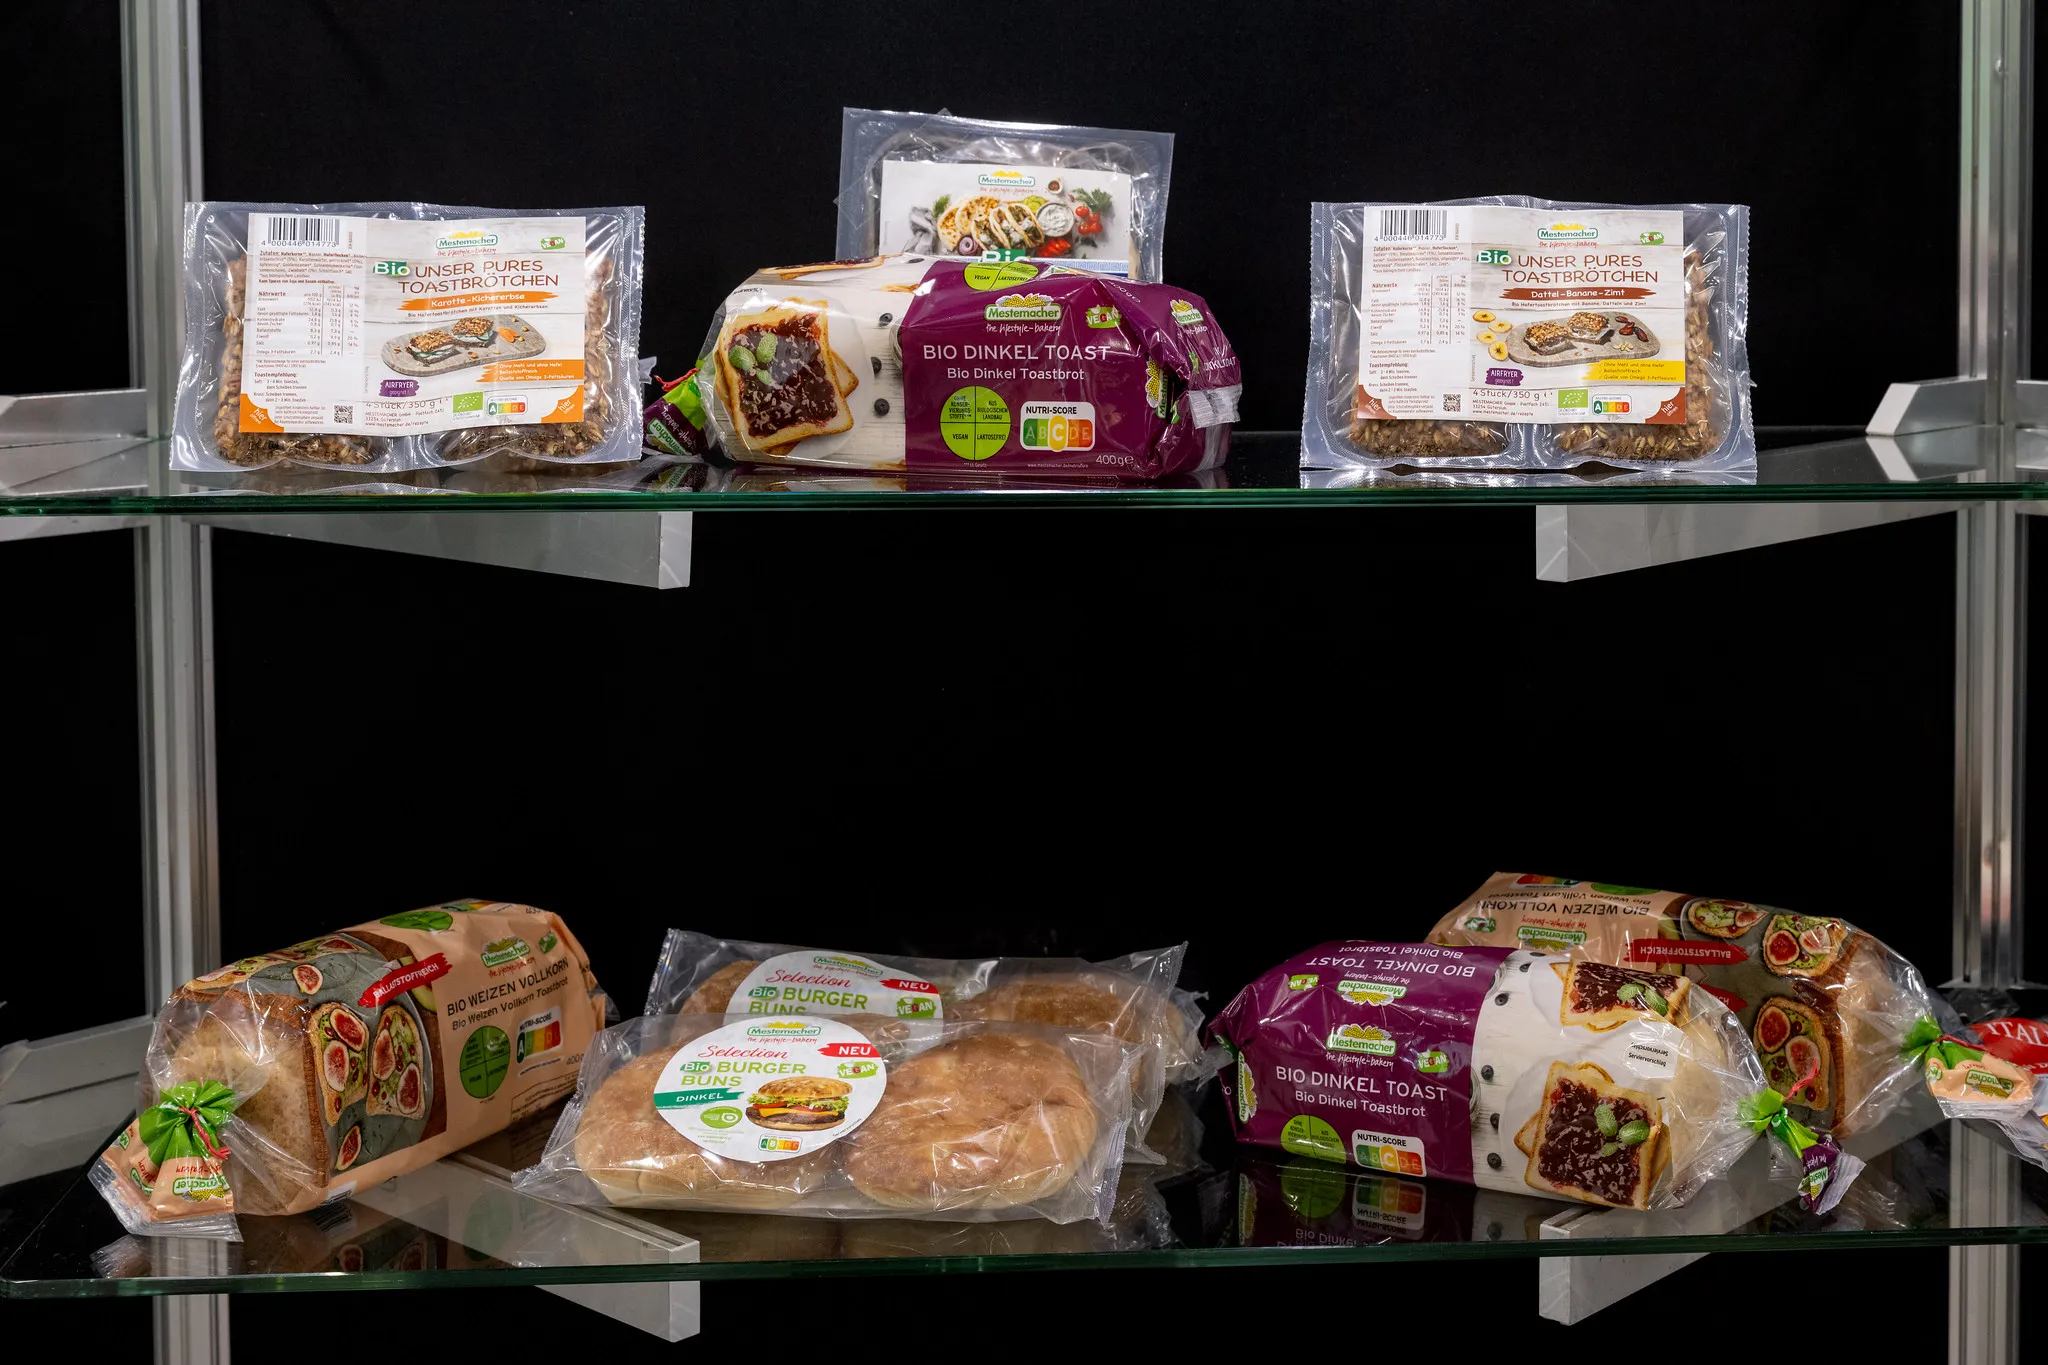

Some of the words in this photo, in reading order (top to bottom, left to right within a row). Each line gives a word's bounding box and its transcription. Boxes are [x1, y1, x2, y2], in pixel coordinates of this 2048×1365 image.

[981, 175, 1033, 185] Mestemacher
[1540, 229, 1596, 238] Mestemacher
[1640, 233, 1663, 244] VEGAN
[305, 240, 337, 248] 014773
[439, 237, 496, 247] Mestemacher
[1477, 251, 1512, 265] Bio
[1517, 255, 1576, 268] UNSER
[1584, 254, 1643, 267] PURES
[374, 261, 411, 276] Bio
[415, 262, 475, 278] UNSER
[483, 260, 543, 273] PURES
[1502, 266, 1658, 284] TOASTBRÖTCHEN
[398, 273, 559, 294] TOASTBRÖTCHEN
[988, 307, 1059, 318] Mestemacher
[1086, 308, 1120, 326] VEGAN
[986, 323, 998, 332] the
[999, 322, 1061, 336] lifestyle-bakery
[923, 345, 957, 360] BIO
[963, 345, 1039, 360] DINKEL
[1045, 345, 1111, 361] TOAST
[947, 368, 970, 379] Bio
[974, 367, 1016, 379] Dinkel
[1020, 367, 1085, 380] Toastbrot
[1490, 370, 1518, 378] AIRFRYER
[384, 381, 414, 389] AIRFRYER
[1533, 393, 1540, 401] g
[557, 399, 571, 411] hier
[1025, 406, 1077, 415] NUTRI-SCORE
[1368, 398, 1381, 412] hier
[1661, 400, 1674, 413] hier
[252, 407, 267, 421] hier
[1051, 423, 1063, 441] C
[1488, 890, 1540, 898] Toastbrot
[1542, 891, 1587, 900] Vollkorn
[1590, 894, 1630, 904] Weizen
[1476, 900, 1557, 914] VOLLKORN
[1563, 904, 1618, 916] WEIZEN
[1623, 906, 1649, 916] BIO
[1519, 928, 1585, 945] Mestemacher
[484, 942, 528, 964] Mestemacher
[1338, 945, 1397, 954] Toastbrot
[1401, 946, 1439, 958] Dinkel
[1442, 950, 1464, 959] Bio
[1640, 946, 1731, 959] BALLASTSTOFFREICH
[817, 957, 882, 976] Mestemacher
[1306, 957, 1366, 969] TOAST
[1374, 959, 1439, 974] DINKEL
[1443, 965, 1476, 978] BIO
[373, 962, 440, 999] BALLASTSTOFFREICH
[766, 969, 853, 988] Selection
[447, 999, 467, 1016] BIO
[468, 981, 516, 1007] WEIZEN
[519, 958, 569, 989] VOLLKORN
[897, 981, 930, 990] NEU
[1340, 981, 1405, 998] Mestemacher
[452, 1020, 466, 1031] Bio
[467, 1007, 498, 1024] Weizen
[500, 992, 535, 1012] Vollkorn
[536, 976, 568, 997] Toastbrot
[751, 988, 776, 997] Bio
[782, 987, 868, 1009] BURGER
[749, 1001, 806, 1016] BUNS
[899, 1002, 934, 1015] VEGAN
[519, 1012, 552, 1031] NUTRI-SCORE
[750, 1027, 819, 1036] Mestemacher
[698, 1045, 789, 1059] Selection
[838, 1046, 871, 1056] NEU
[1325, 1052, 1336, 1062] the
[1337, 1053, 1394, 1072] lifestyle-bakery
[1418, 1056, 1447, 1069] VEGAN
[1628, 1052, 1667, 1067] Serviervorschlag
[683, 1062, 710, 1072] Bio
[716, 1061, 807, 1074] BURGER
[838, 1063, 875, 1076] VEGAN
[680, 1075, 743, 1087] BUNS
[1276, 1065, 1306, 1083] BIO
[1311, 1072, 1381, 1094] DINKEL
[1386, 1080, 1448, 1101] TOAST
[676, 1091, 724, 1103] DINKEL
[1295, 1091, 1315, 1103] Bio
[1318, 1093, 1357, 1109] Dinkel
[1360, 1100, 1426, 1117] Toastbrot
[1357, 1133, 1407, 1147] NUTRI-SCORE
[1384, 1153, 1396, 1167] C
